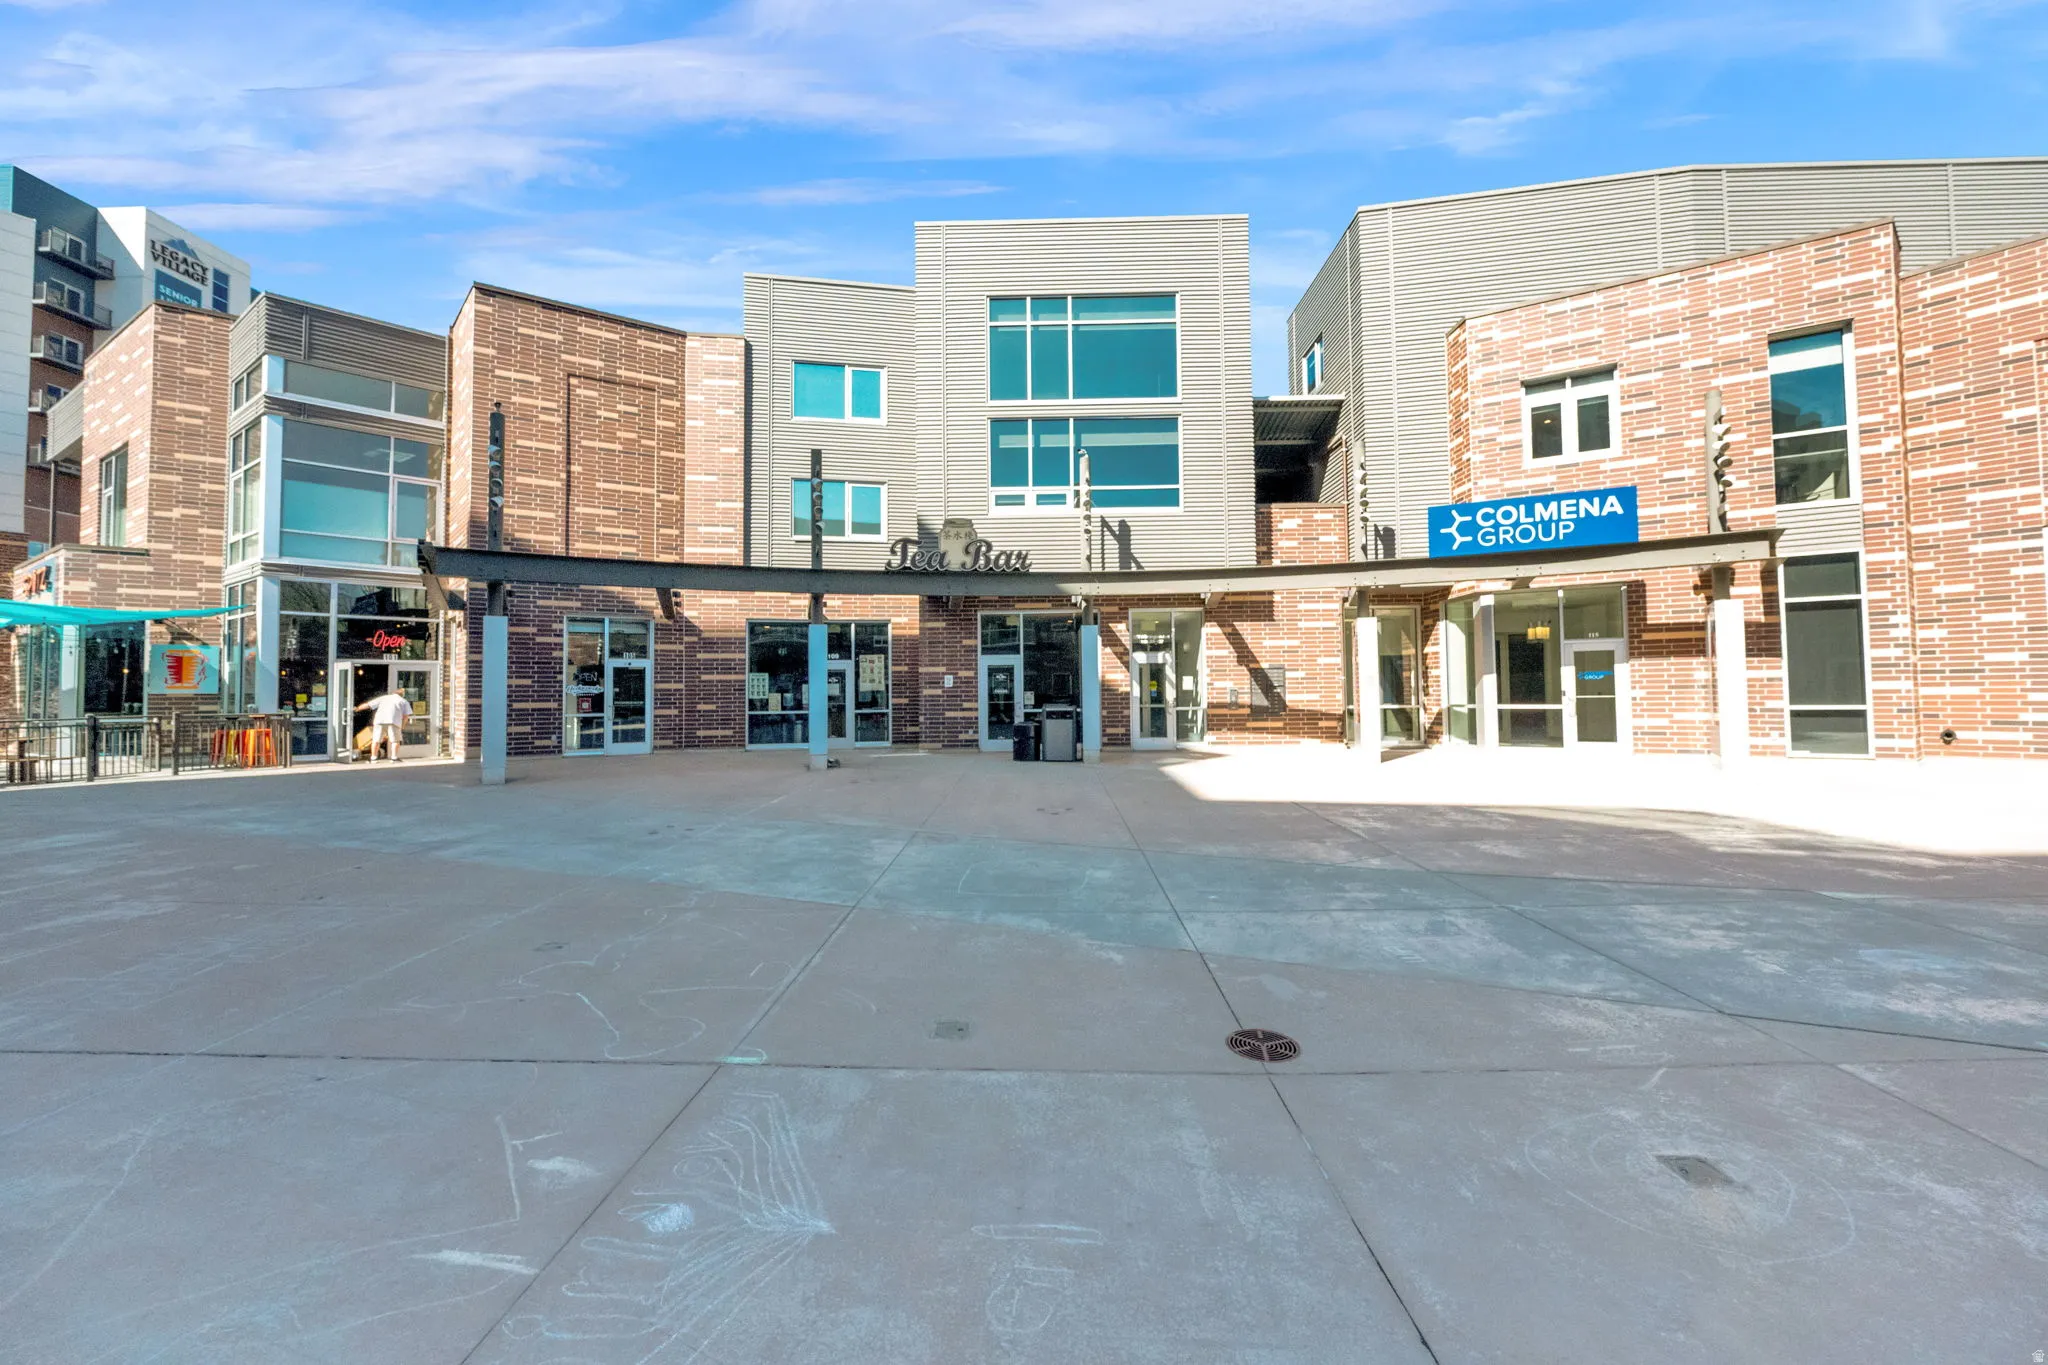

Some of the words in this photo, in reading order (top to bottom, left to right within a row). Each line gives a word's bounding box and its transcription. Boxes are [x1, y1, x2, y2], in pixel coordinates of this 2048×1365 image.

[150, 239, 208, 276] LEGACY
[150, 250, 208, 287] VILLAGE
[158, 284, 198, 307] SENIOR
[1475, 494, 1624, 527] COLMENA
[1476, 520, 1576, 547] GROUP
[885, 537, 951, 572] Tea
[961, 538, 1033, 572] Bar
[373, 629, 406, 651] Open
